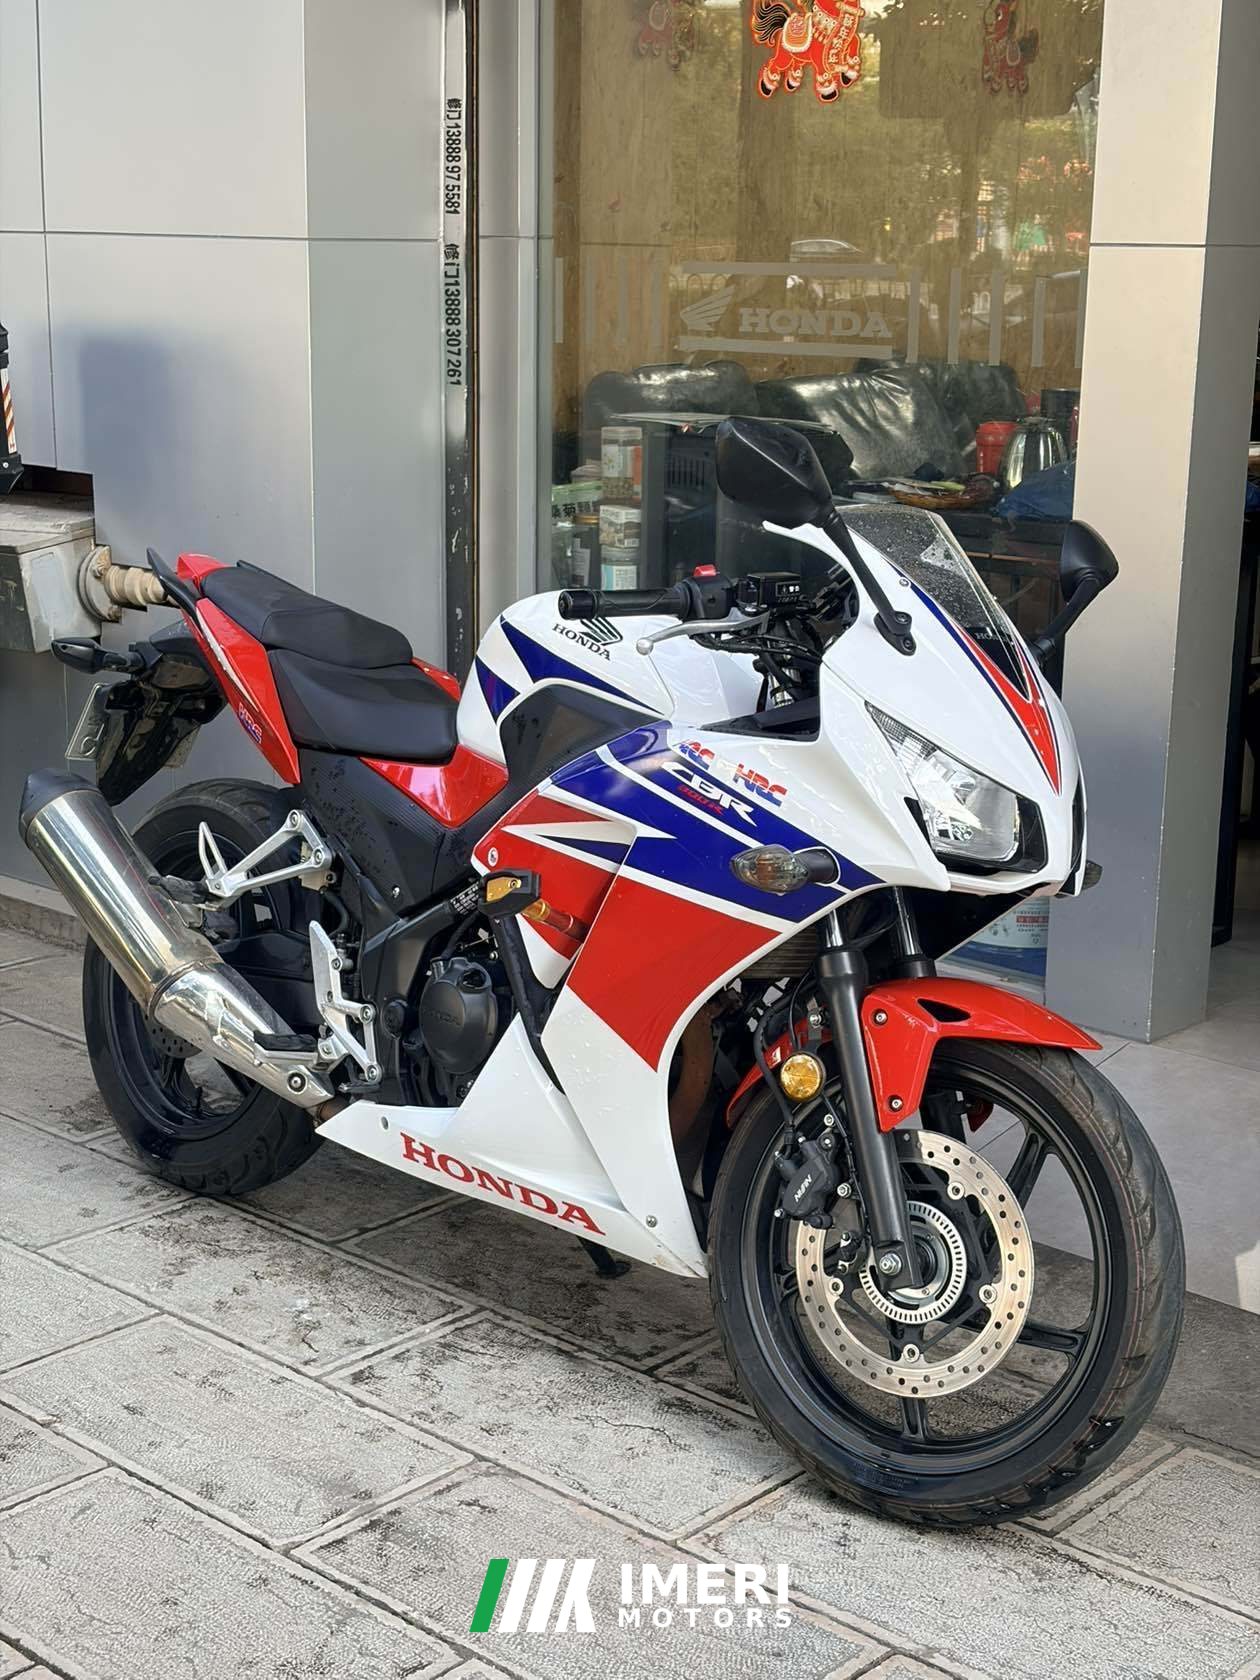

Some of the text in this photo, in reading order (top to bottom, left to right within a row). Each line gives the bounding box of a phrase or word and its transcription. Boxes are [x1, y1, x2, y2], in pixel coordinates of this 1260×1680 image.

[446, 122, 462, 163] 13888
[445, 165, 462, 181] 97
[445, 184, 461, 214] 5581
[738, 307, 893, 338] HONDA
[446, 328, 462, 356] 307
[551, 623, 612, 661] HONDA
[661, 762, 758, 827] CBR
[732, 763, 788, 807] HRC
[400, 1132, 606, 1236] HONDA
